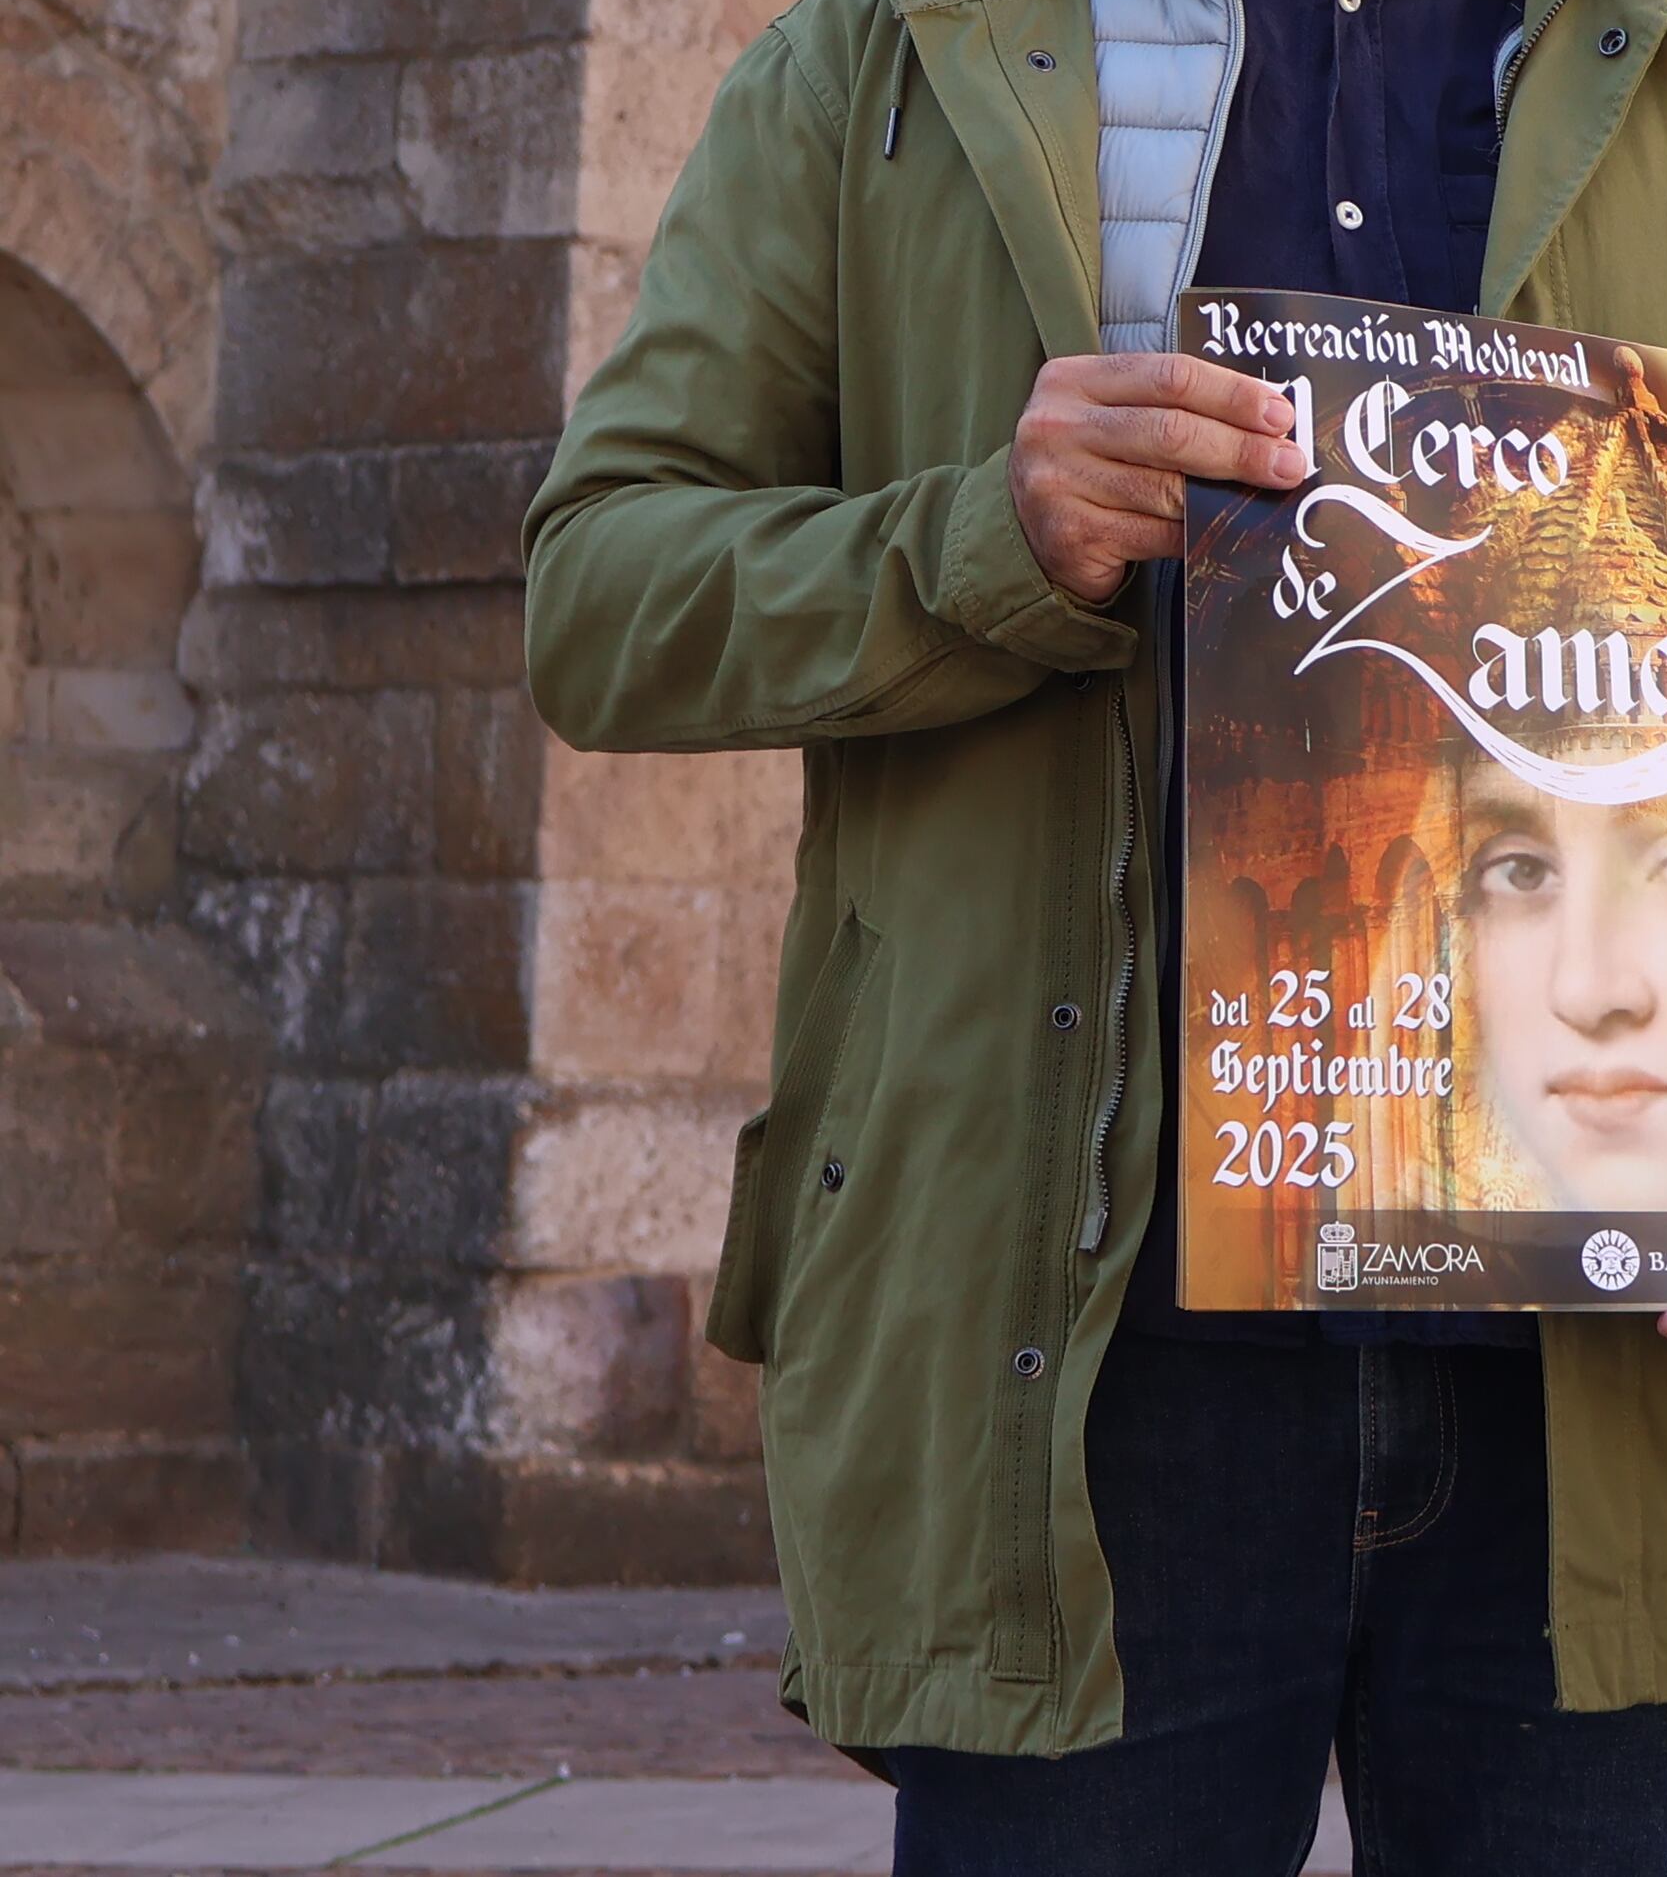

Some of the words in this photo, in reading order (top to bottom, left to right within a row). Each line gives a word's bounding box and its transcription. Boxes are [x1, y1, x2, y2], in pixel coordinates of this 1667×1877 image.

[1198, 300, 1418, 366] Recreación
[1424, 317, 1591, 388] Medieval
[1262, 369, 1321, 479] l
[1344, 375, 1568, 496] Cerco
[1272, 545, 1338, 619] de
[1211, 989, 1249, 1026] del
[1267, 970, 1331, 1027] 25
[1348, 996, 1376, 1029] al
[1393, 973, 1451, 1030] 28
[1211, 1039, 1453, 1113] Septiembre
[1212, 1121, 1355, 1188] 2025
[1361, 1276, 1439, 1285] AYUNTAMIENTO
[1362, 1243, 1484, 1272] ZAMORA
